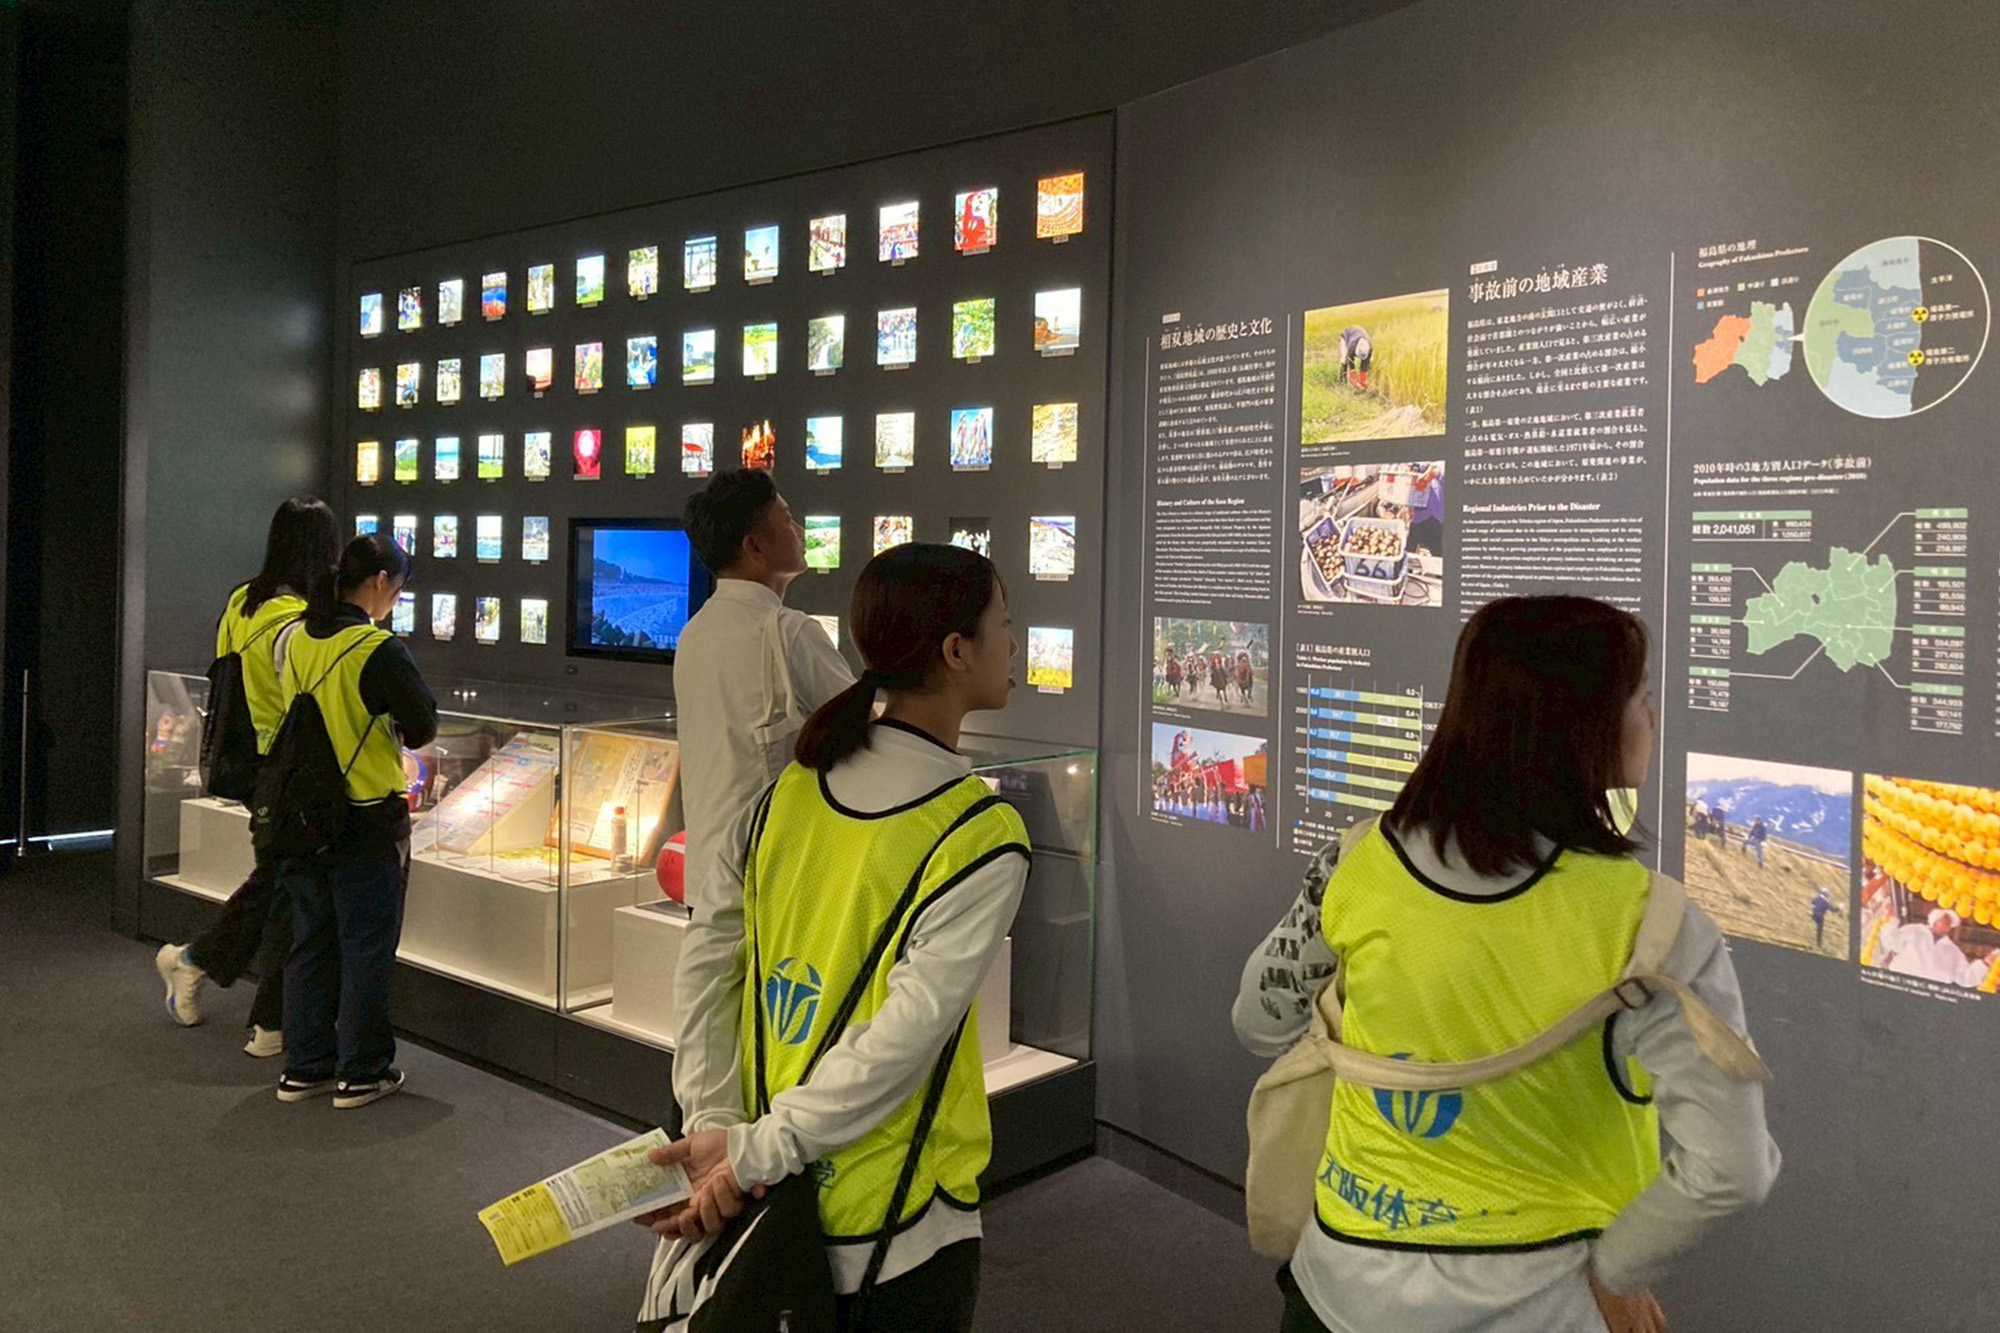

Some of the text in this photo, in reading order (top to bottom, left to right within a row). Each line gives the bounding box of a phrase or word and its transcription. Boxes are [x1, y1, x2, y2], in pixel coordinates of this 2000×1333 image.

[1467, 263, 1608, 303] 事故前の地域産業
[1160, 318, 1273, 350] 相双地域の歴史と文化
[1463, 504, 1492, 514] Regional
[1493, 503, 1527, 513] Industries
[1528, 503, 1547, 512] Prior
[1557, 503, 1569, 511] the
[1570, 502, 1601, 511] Disaster
[1713, 524, 1756, 535] 2,041,051
